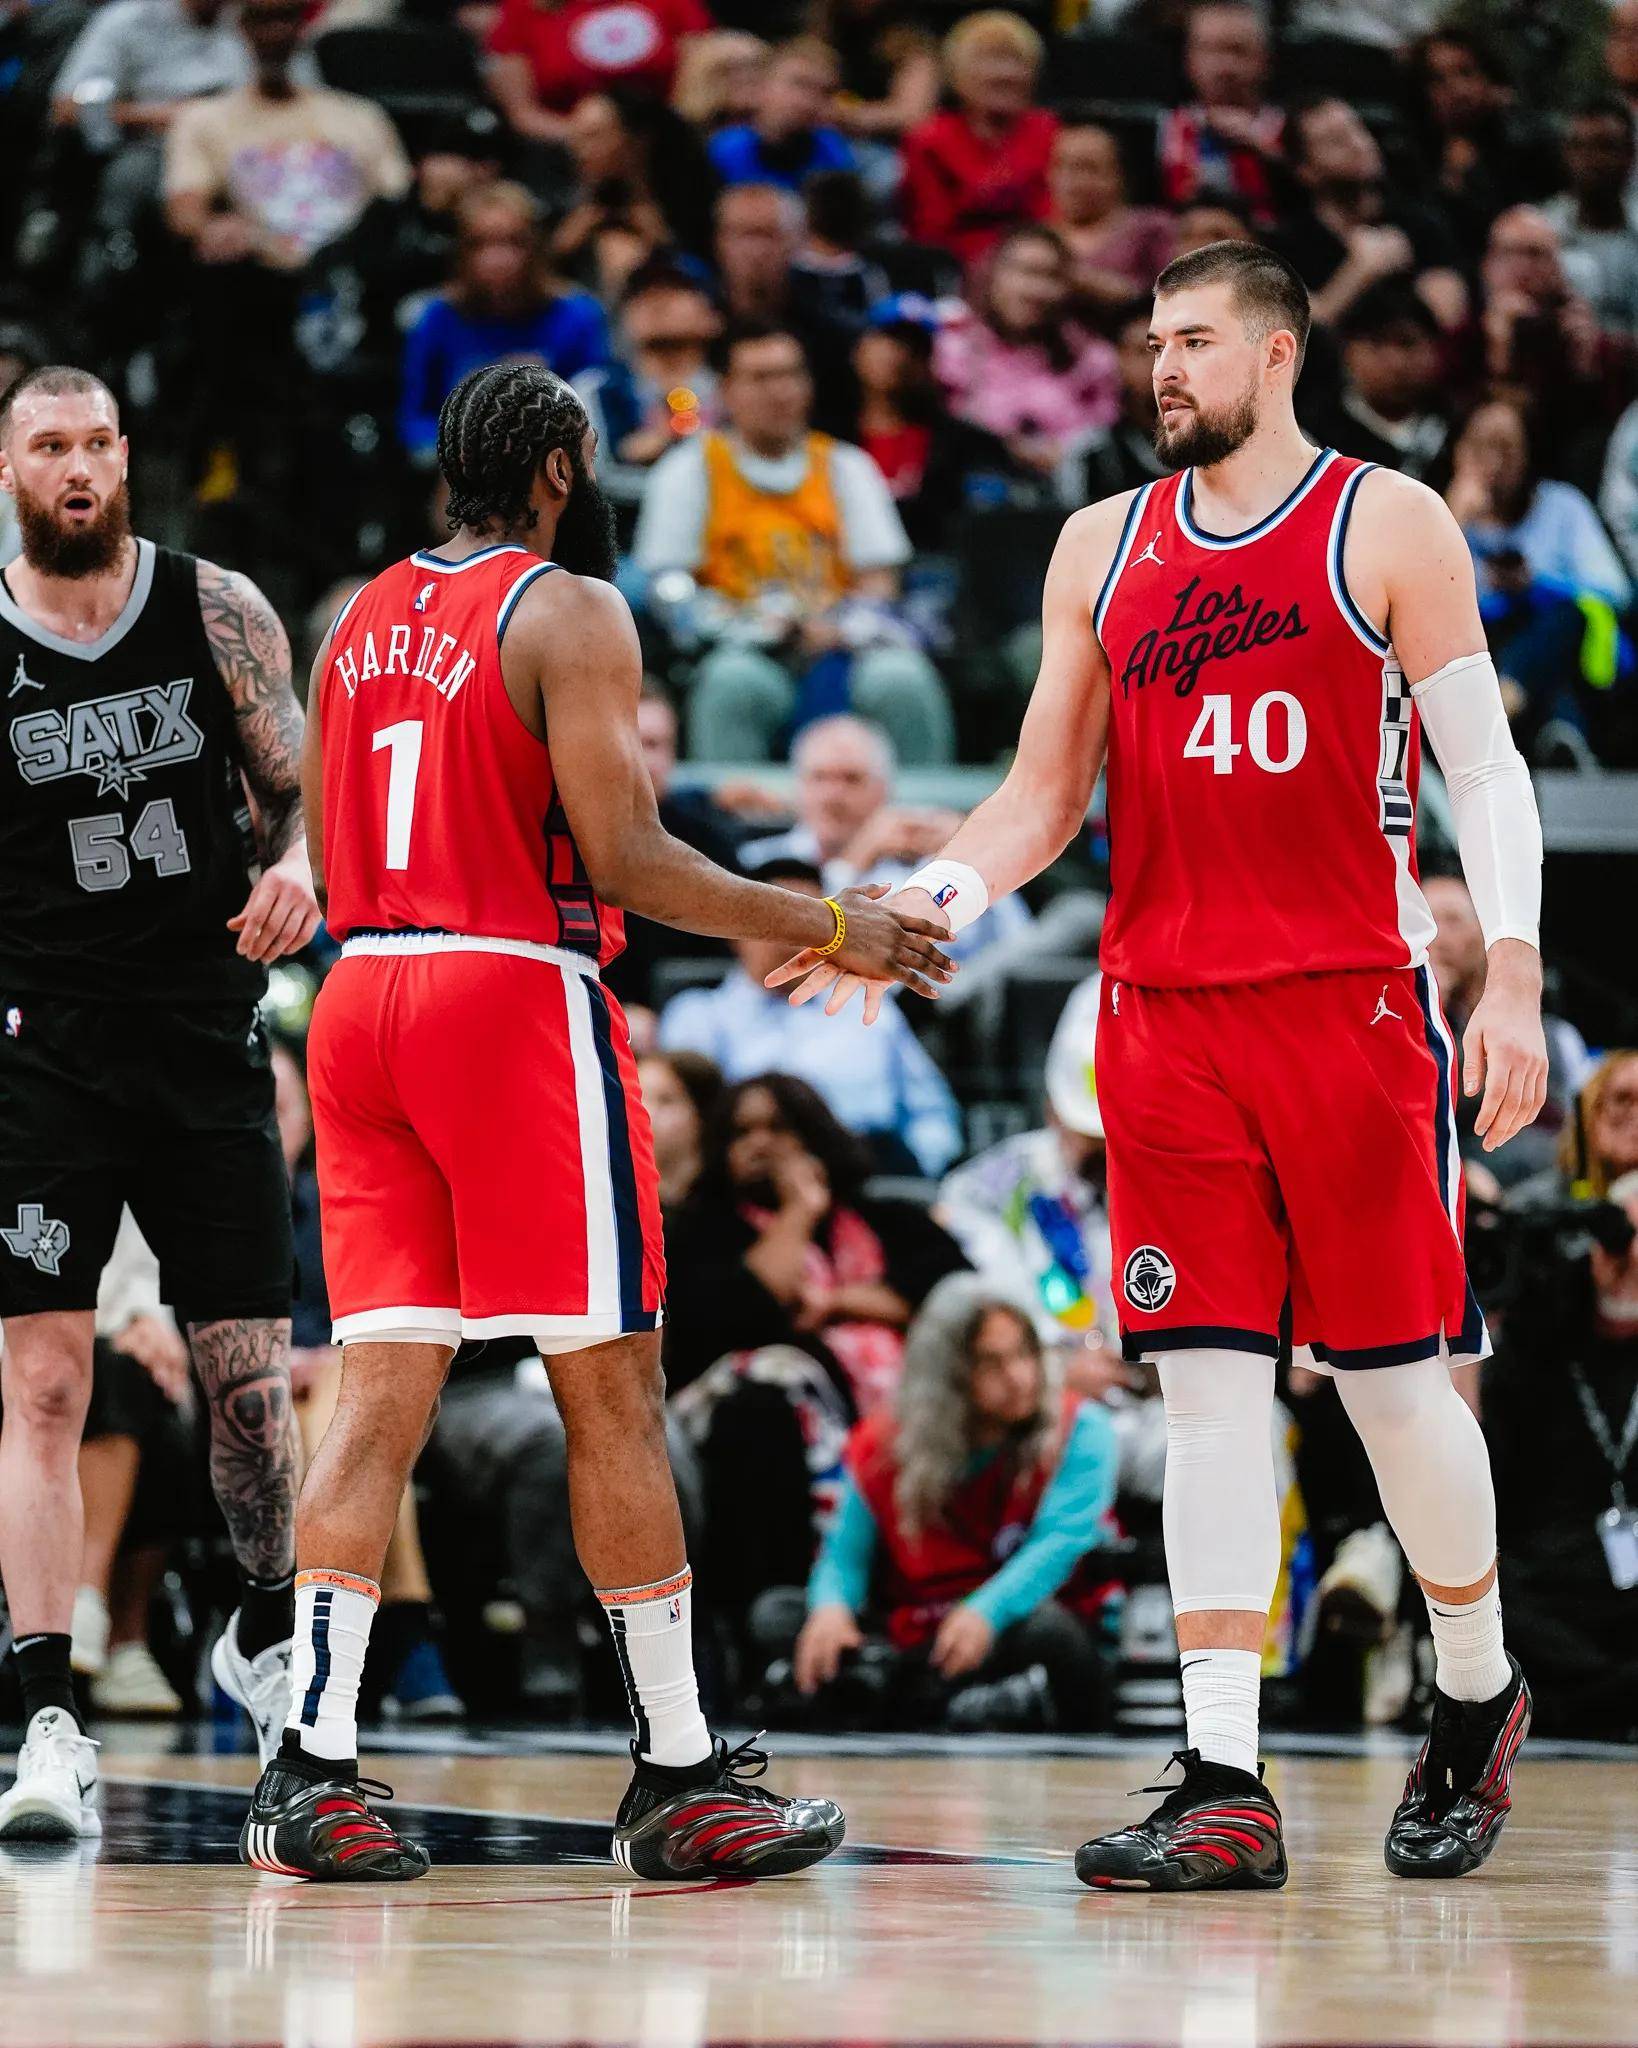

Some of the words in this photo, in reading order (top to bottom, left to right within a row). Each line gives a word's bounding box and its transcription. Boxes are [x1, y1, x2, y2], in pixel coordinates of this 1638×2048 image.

[1120, 598, 1310, 700] Angeles
[1164, 576, 1249, 636] Los
[335, 624, 476, 702] HARDEN
[9, 677, 205, 786] SATX
[1183, 690, 1307, 774] 40
[372, 719, 424, 870] 1
[68, 798, 191, 892] 54
